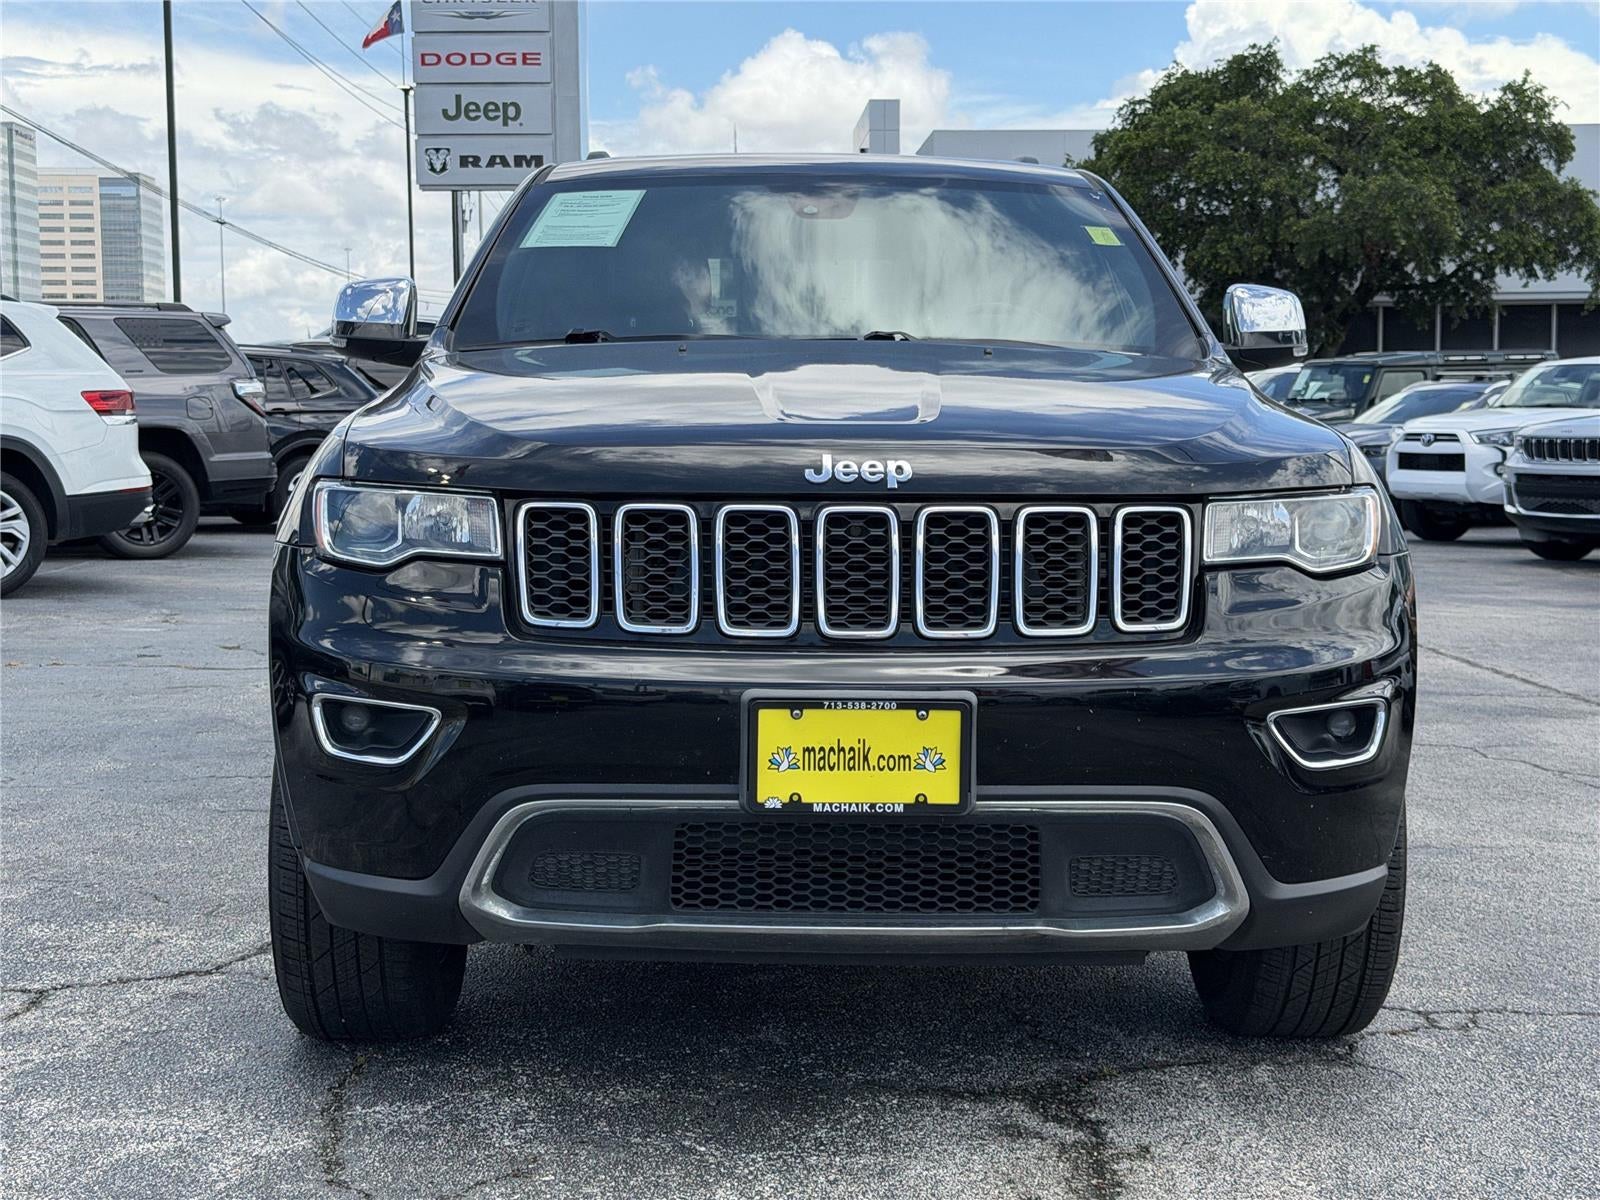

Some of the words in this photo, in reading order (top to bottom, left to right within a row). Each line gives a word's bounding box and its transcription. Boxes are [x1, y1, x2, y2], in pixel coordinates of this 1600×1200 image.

[420, 52, 542, 67] DODGE
[441, 94, 523, 127] Jeep
[459, 155, 544, 168] RAM
[804, 454, 912, 489] Jeep
[823, 701, 897, 710] 713-538-2700
[802, 738, 912, 772] machaik.com
[813, 803, 904, 813] MACHAIK.COM
